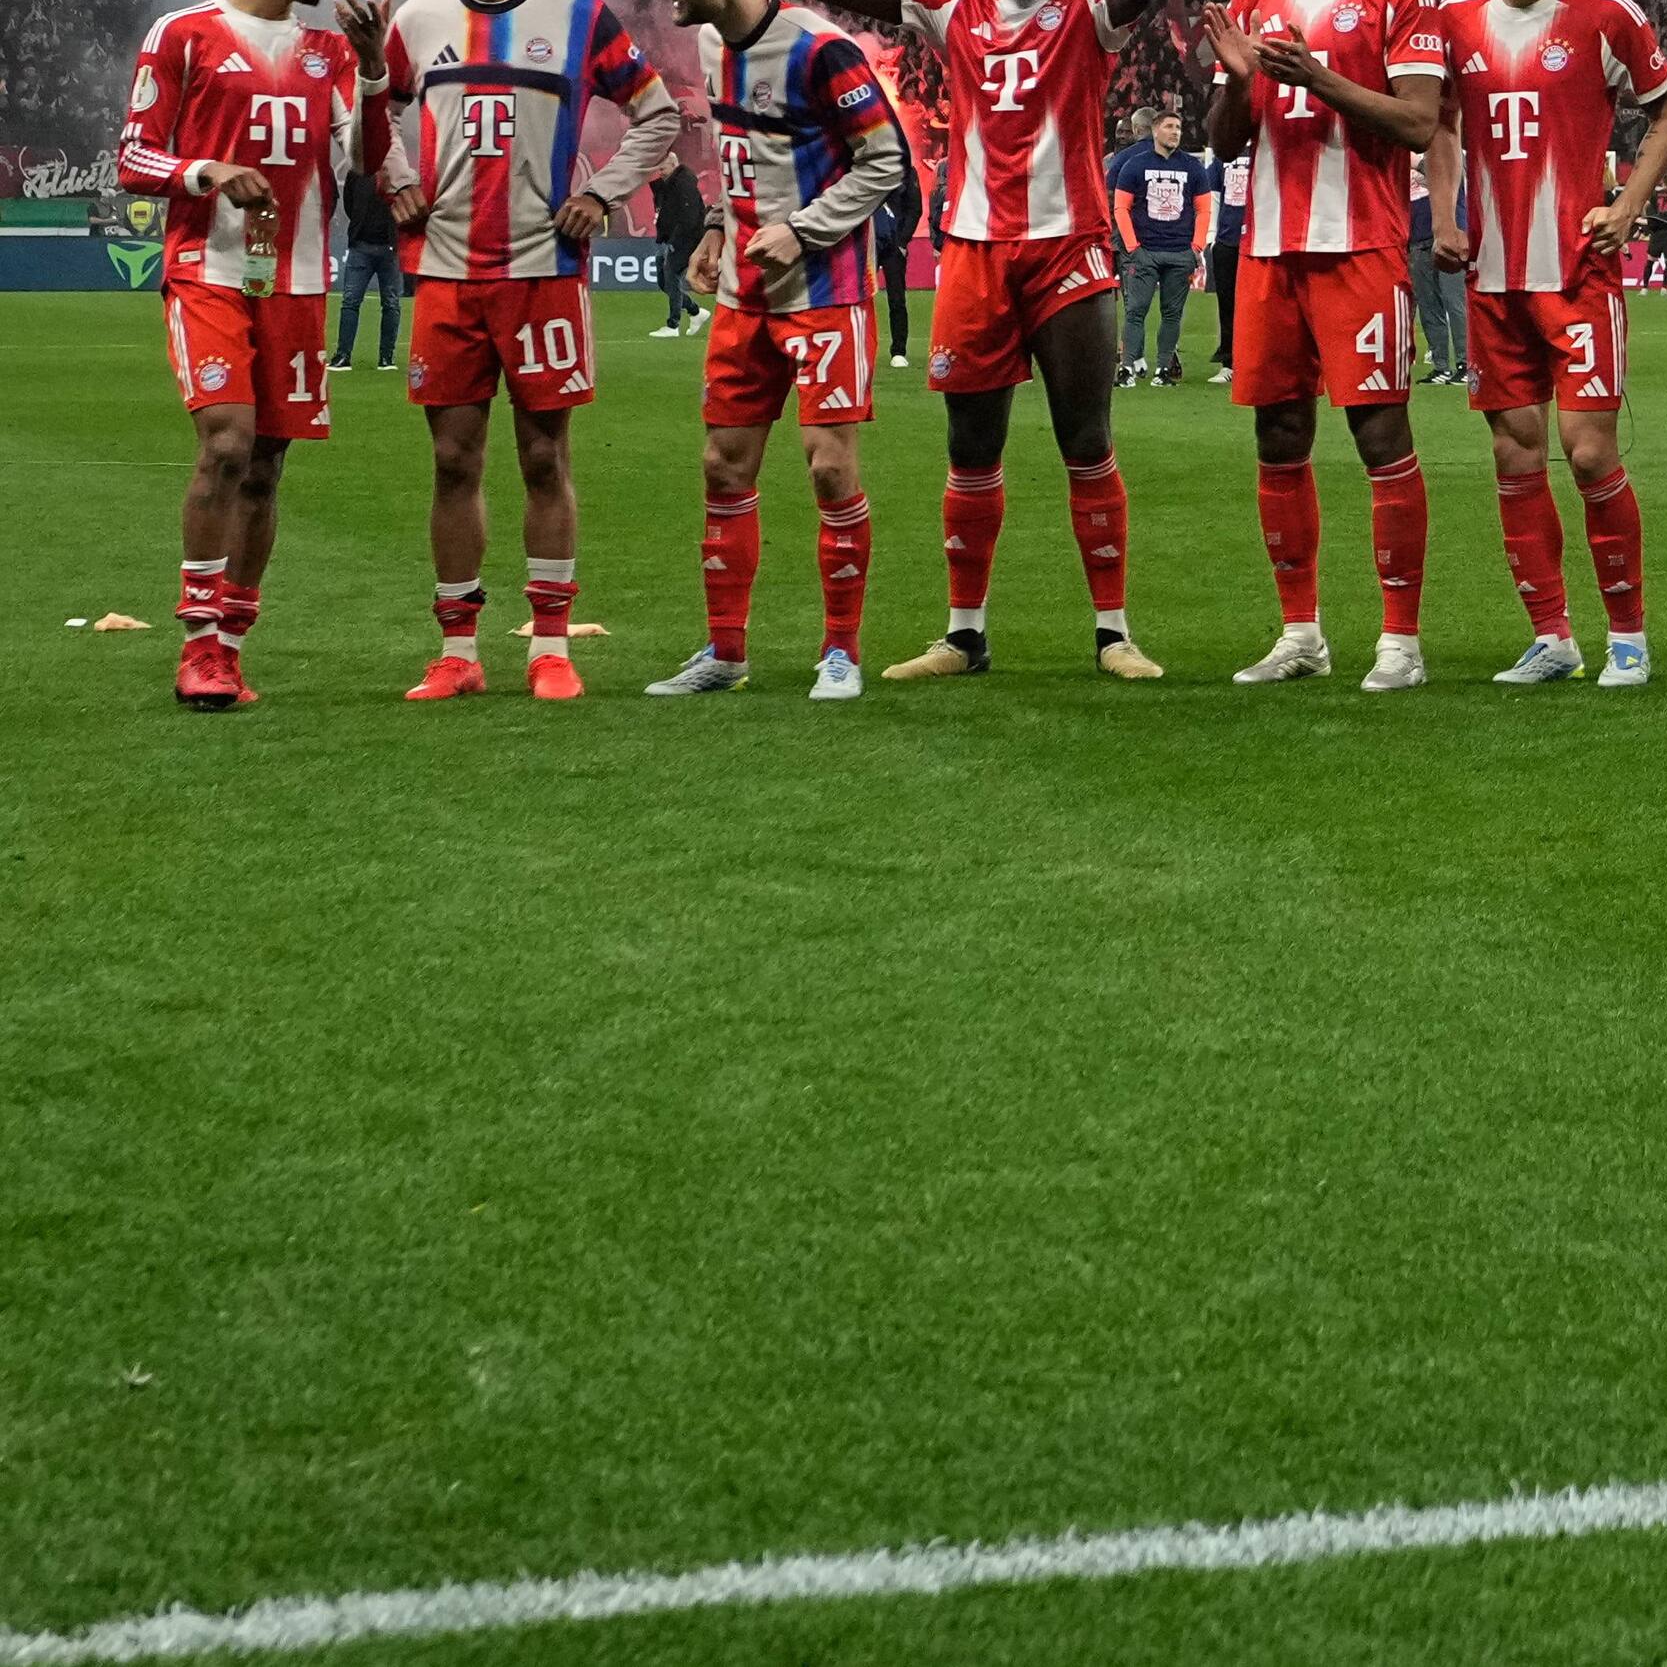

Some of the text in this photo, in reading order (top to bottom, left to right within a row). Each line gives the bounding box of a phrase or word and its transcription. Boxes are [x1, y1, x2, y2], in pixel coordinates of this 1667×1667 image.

[515, 318, 579, 375] 10
[785, 331, 845, 386] 27
[1355, 312, 1385, 364] 4
[1566, 323, 1595, 374] 3
